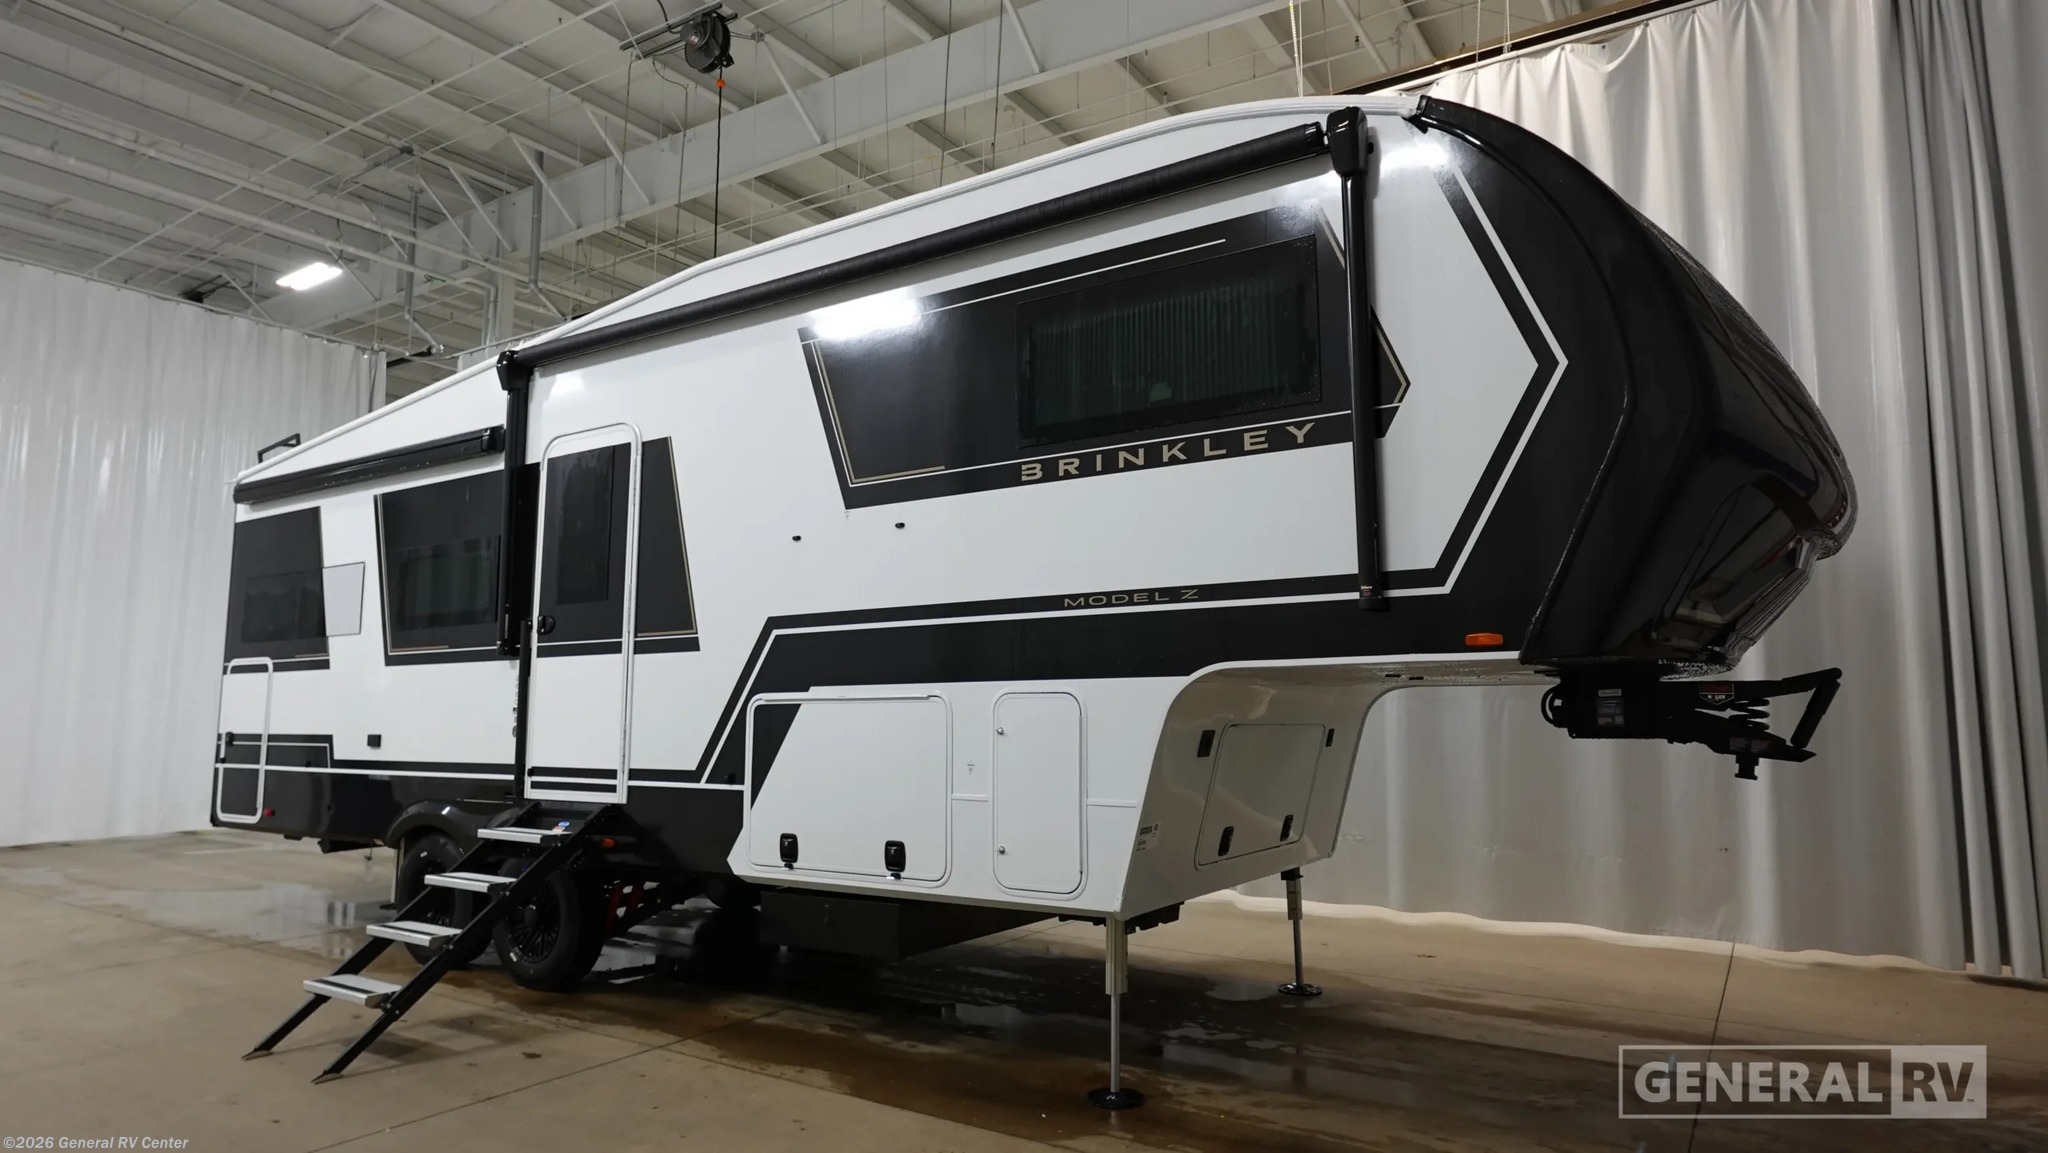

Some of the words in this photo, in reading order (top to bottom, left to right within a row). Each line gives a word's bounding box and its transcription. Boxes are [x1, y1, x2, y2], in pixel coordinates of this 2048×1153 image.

[1021, 422, 1315, 481] BRINKLEY
[1064, 592, 1170, 607] MODEL
[1180, 589, 1199, 600] Z
